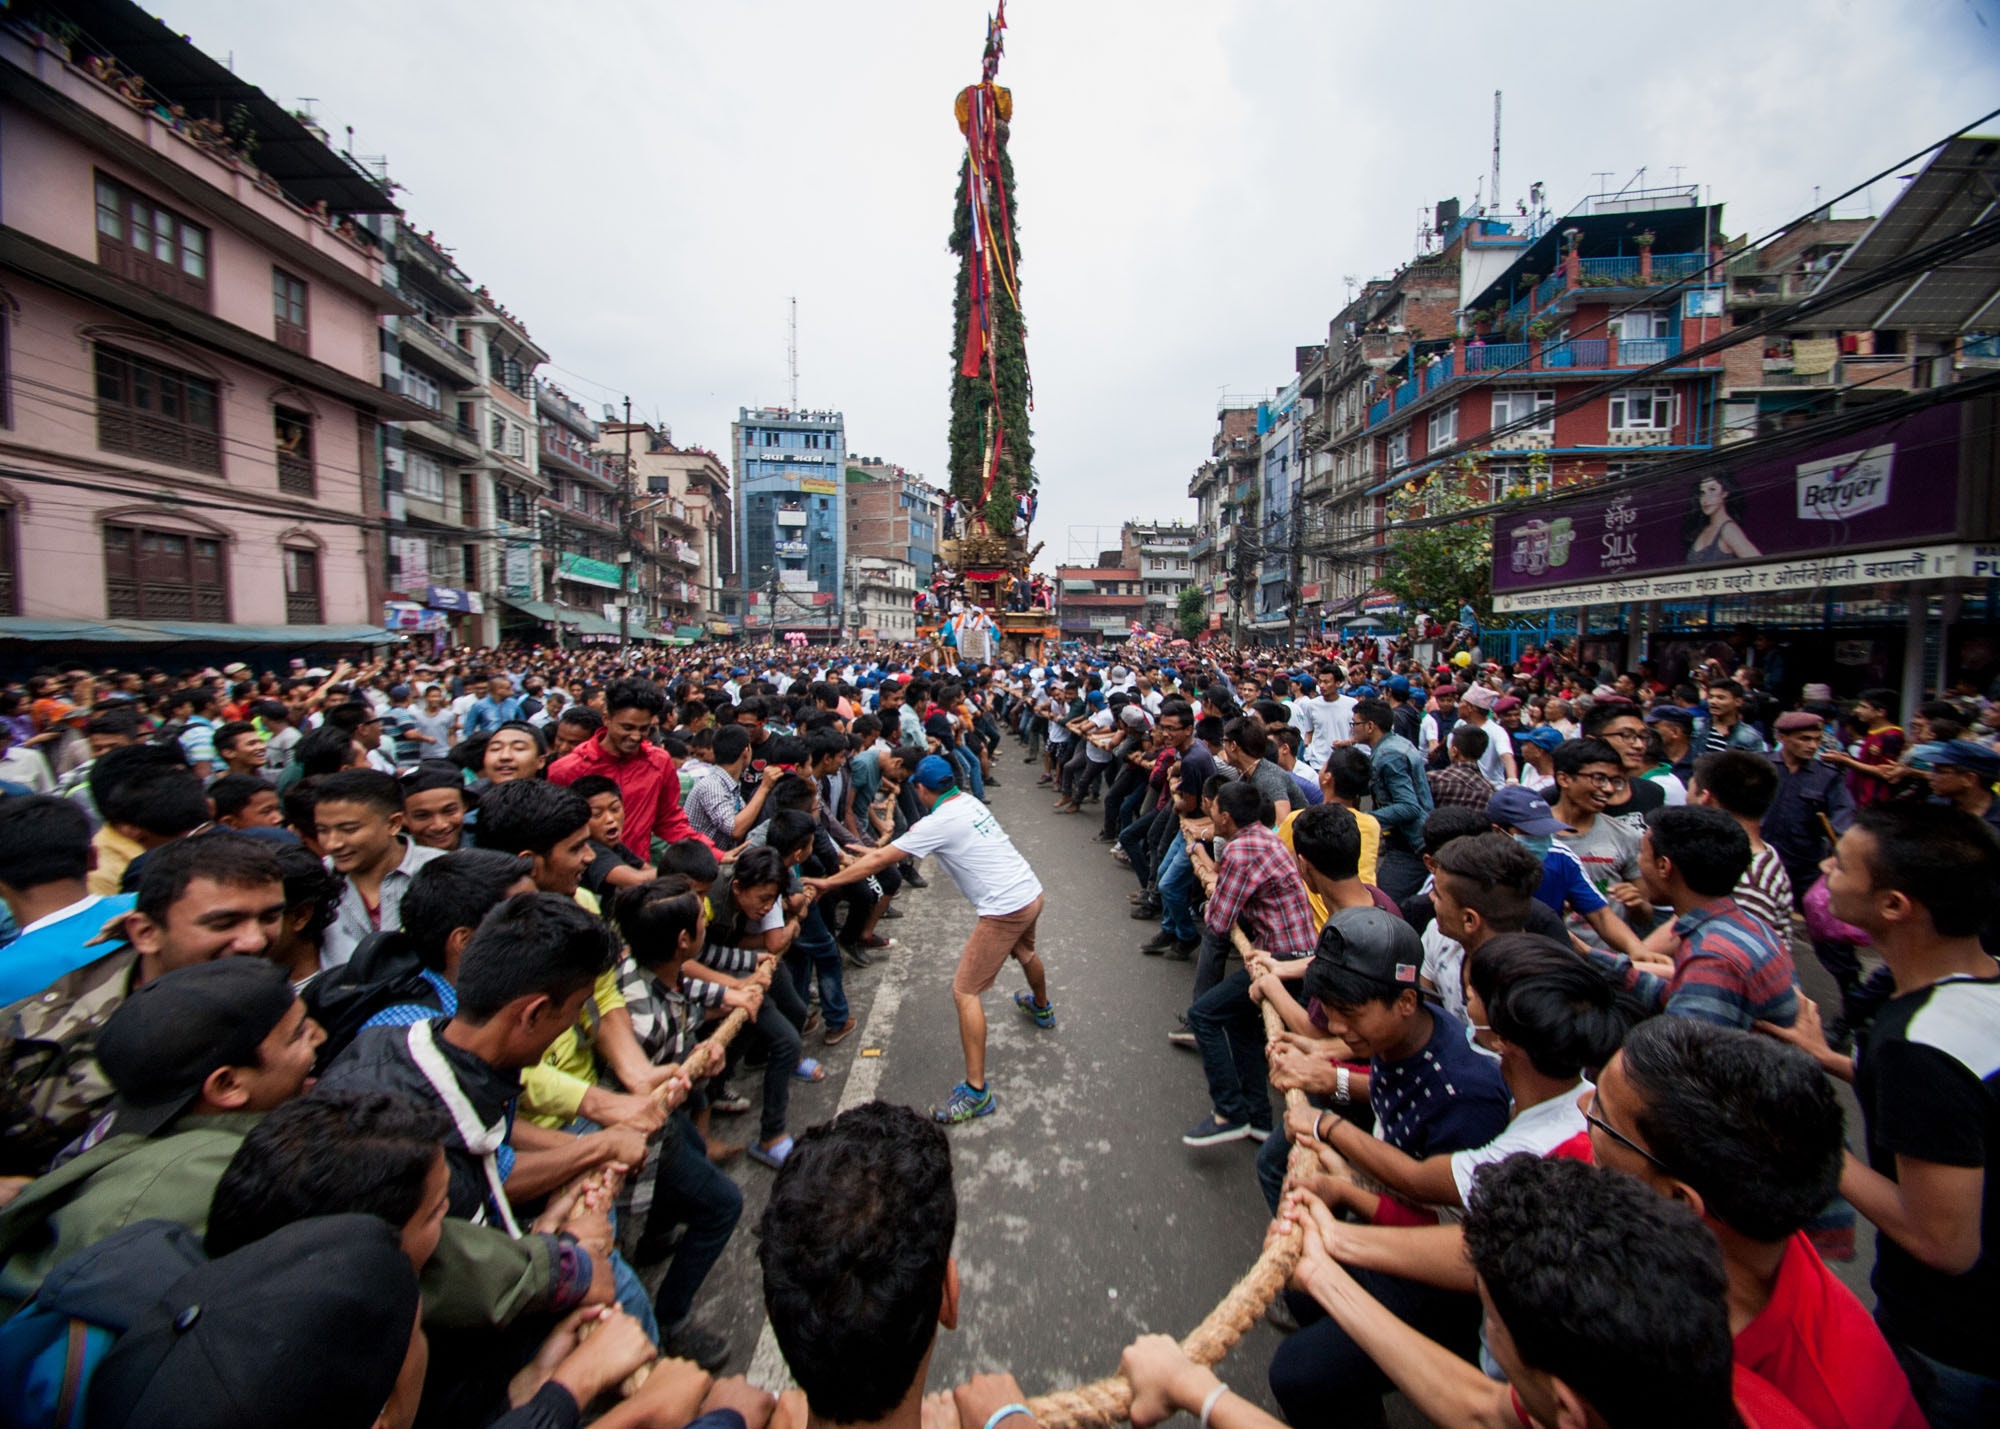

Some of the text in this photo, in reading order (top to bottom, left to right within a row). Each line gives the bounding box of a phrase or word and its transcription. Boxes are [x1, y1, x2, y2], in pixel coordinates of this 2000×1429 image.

[1804, 478, 1882, 507] Berger
[1601, 532, 1637, 559] SILK
[1653, 581, 1693, 596] स्थानमा
[1758, 572, 1769, 588] र
